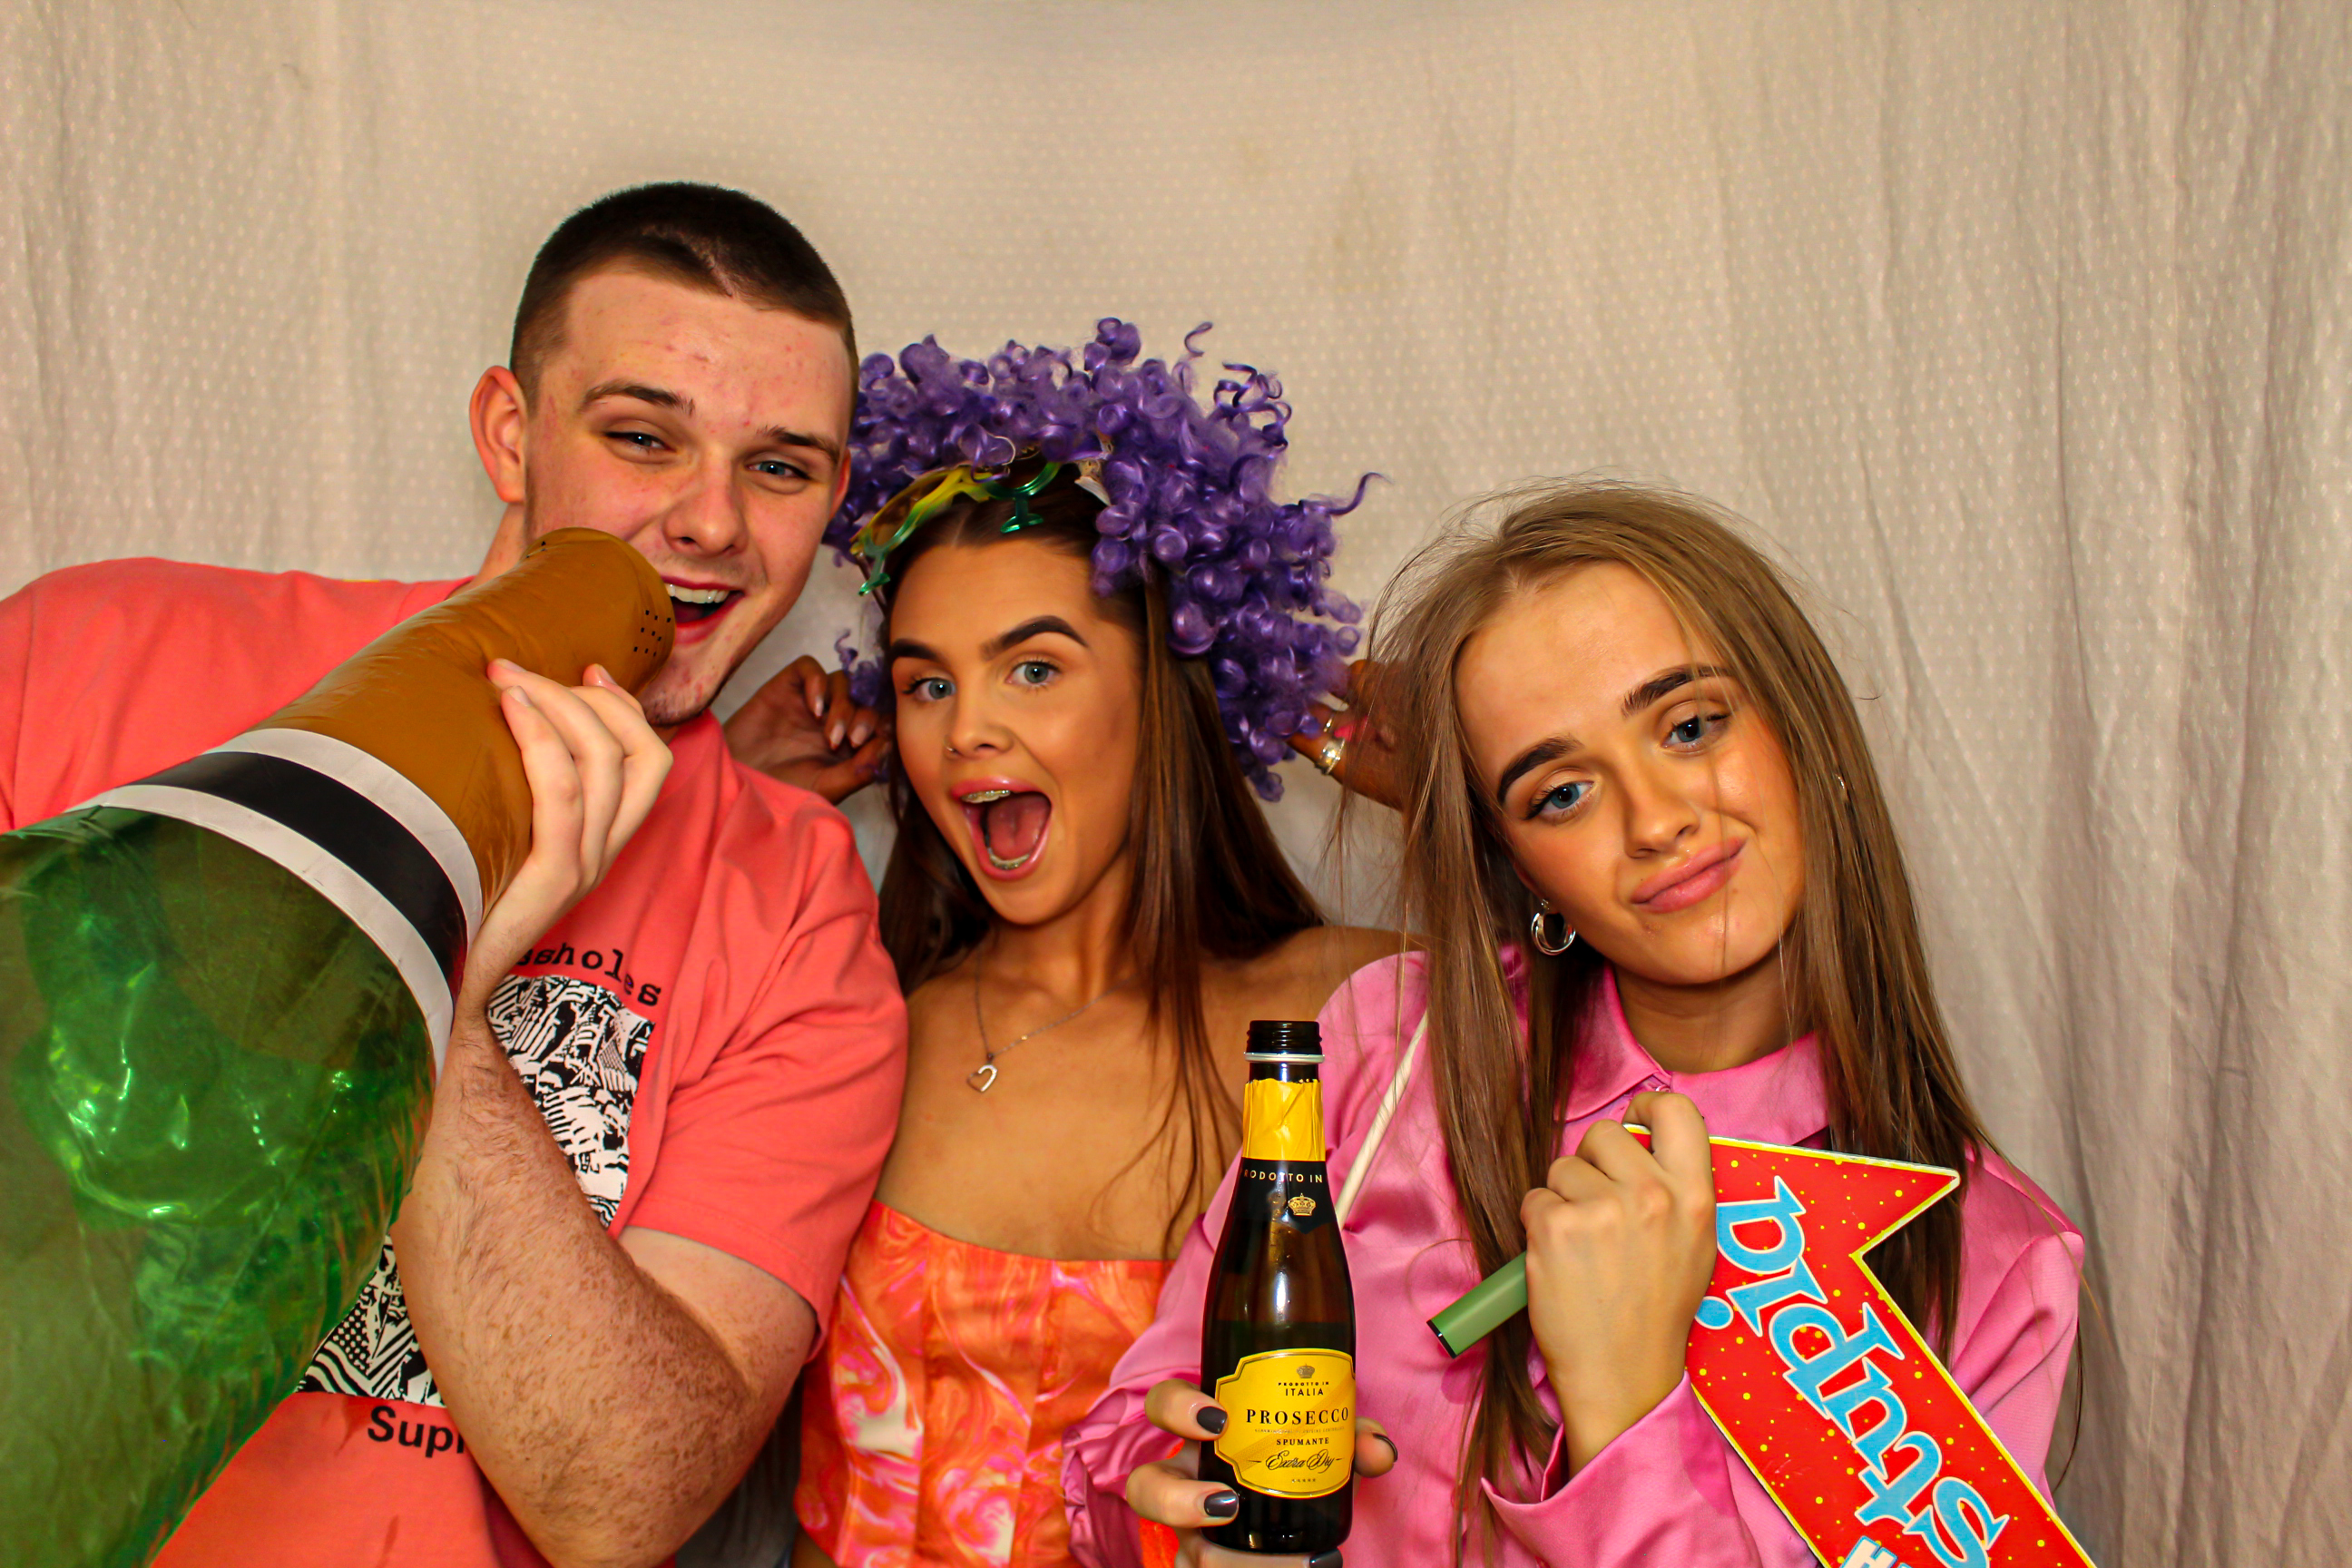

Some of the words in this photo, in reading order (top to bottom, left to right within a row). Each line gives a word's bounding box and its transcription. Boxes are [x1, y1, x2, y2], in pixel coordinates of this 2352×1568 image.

[516, 943, 662, 1006] ssholes
[1243, 1169, 1304, 1182] RODOTTO
[1309, 1174, 1323, 1183] IN
[1285, 1387, 1324, 1396] ITALIA
[1246, 1406, 1348, 1426] PROSECCO
[1276, 1436, 1329, 1446] SPUMANTE
[1265, 1449, 1307, 1471] Extra
[1306, 1448, 1336, 1474] Dry
